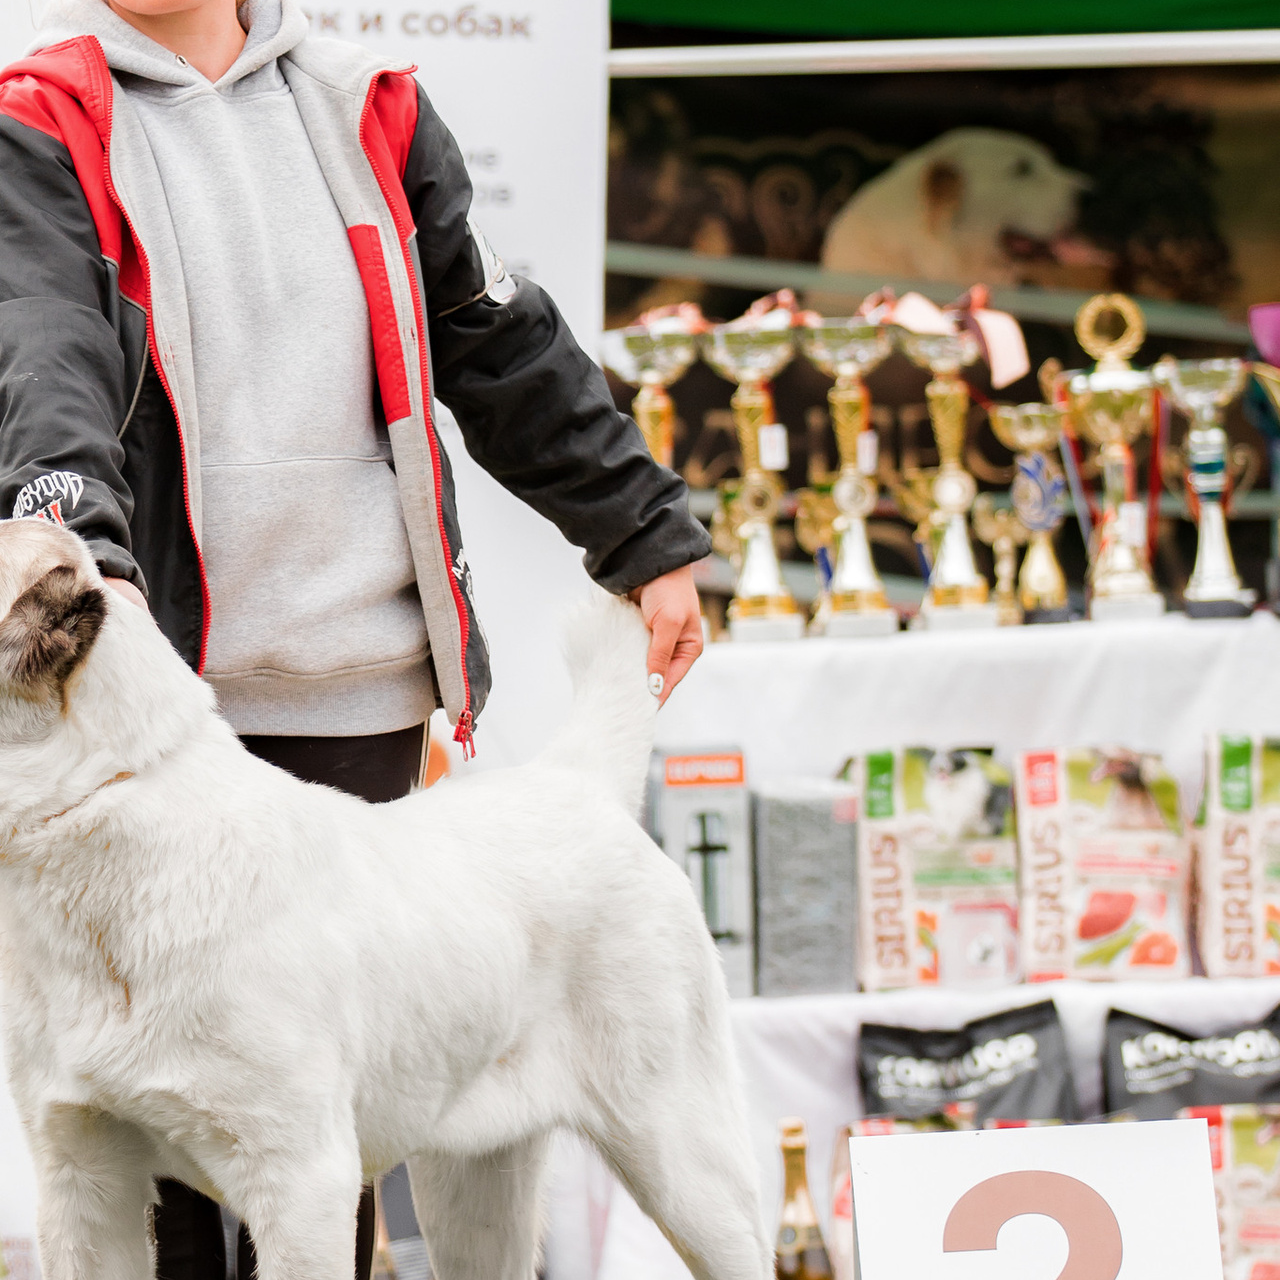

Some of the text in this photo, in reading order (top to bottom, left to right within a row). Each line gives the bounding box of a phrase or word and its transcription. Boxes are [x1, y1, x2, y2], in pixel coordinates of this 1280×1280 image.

[400, 5, 532, 39] собак
[871, 833, 909, 969] SIRIUS
[1030, 819, 1066, 955] SIRIUS
[1222, 823, 1255, 962] SIRIUS
